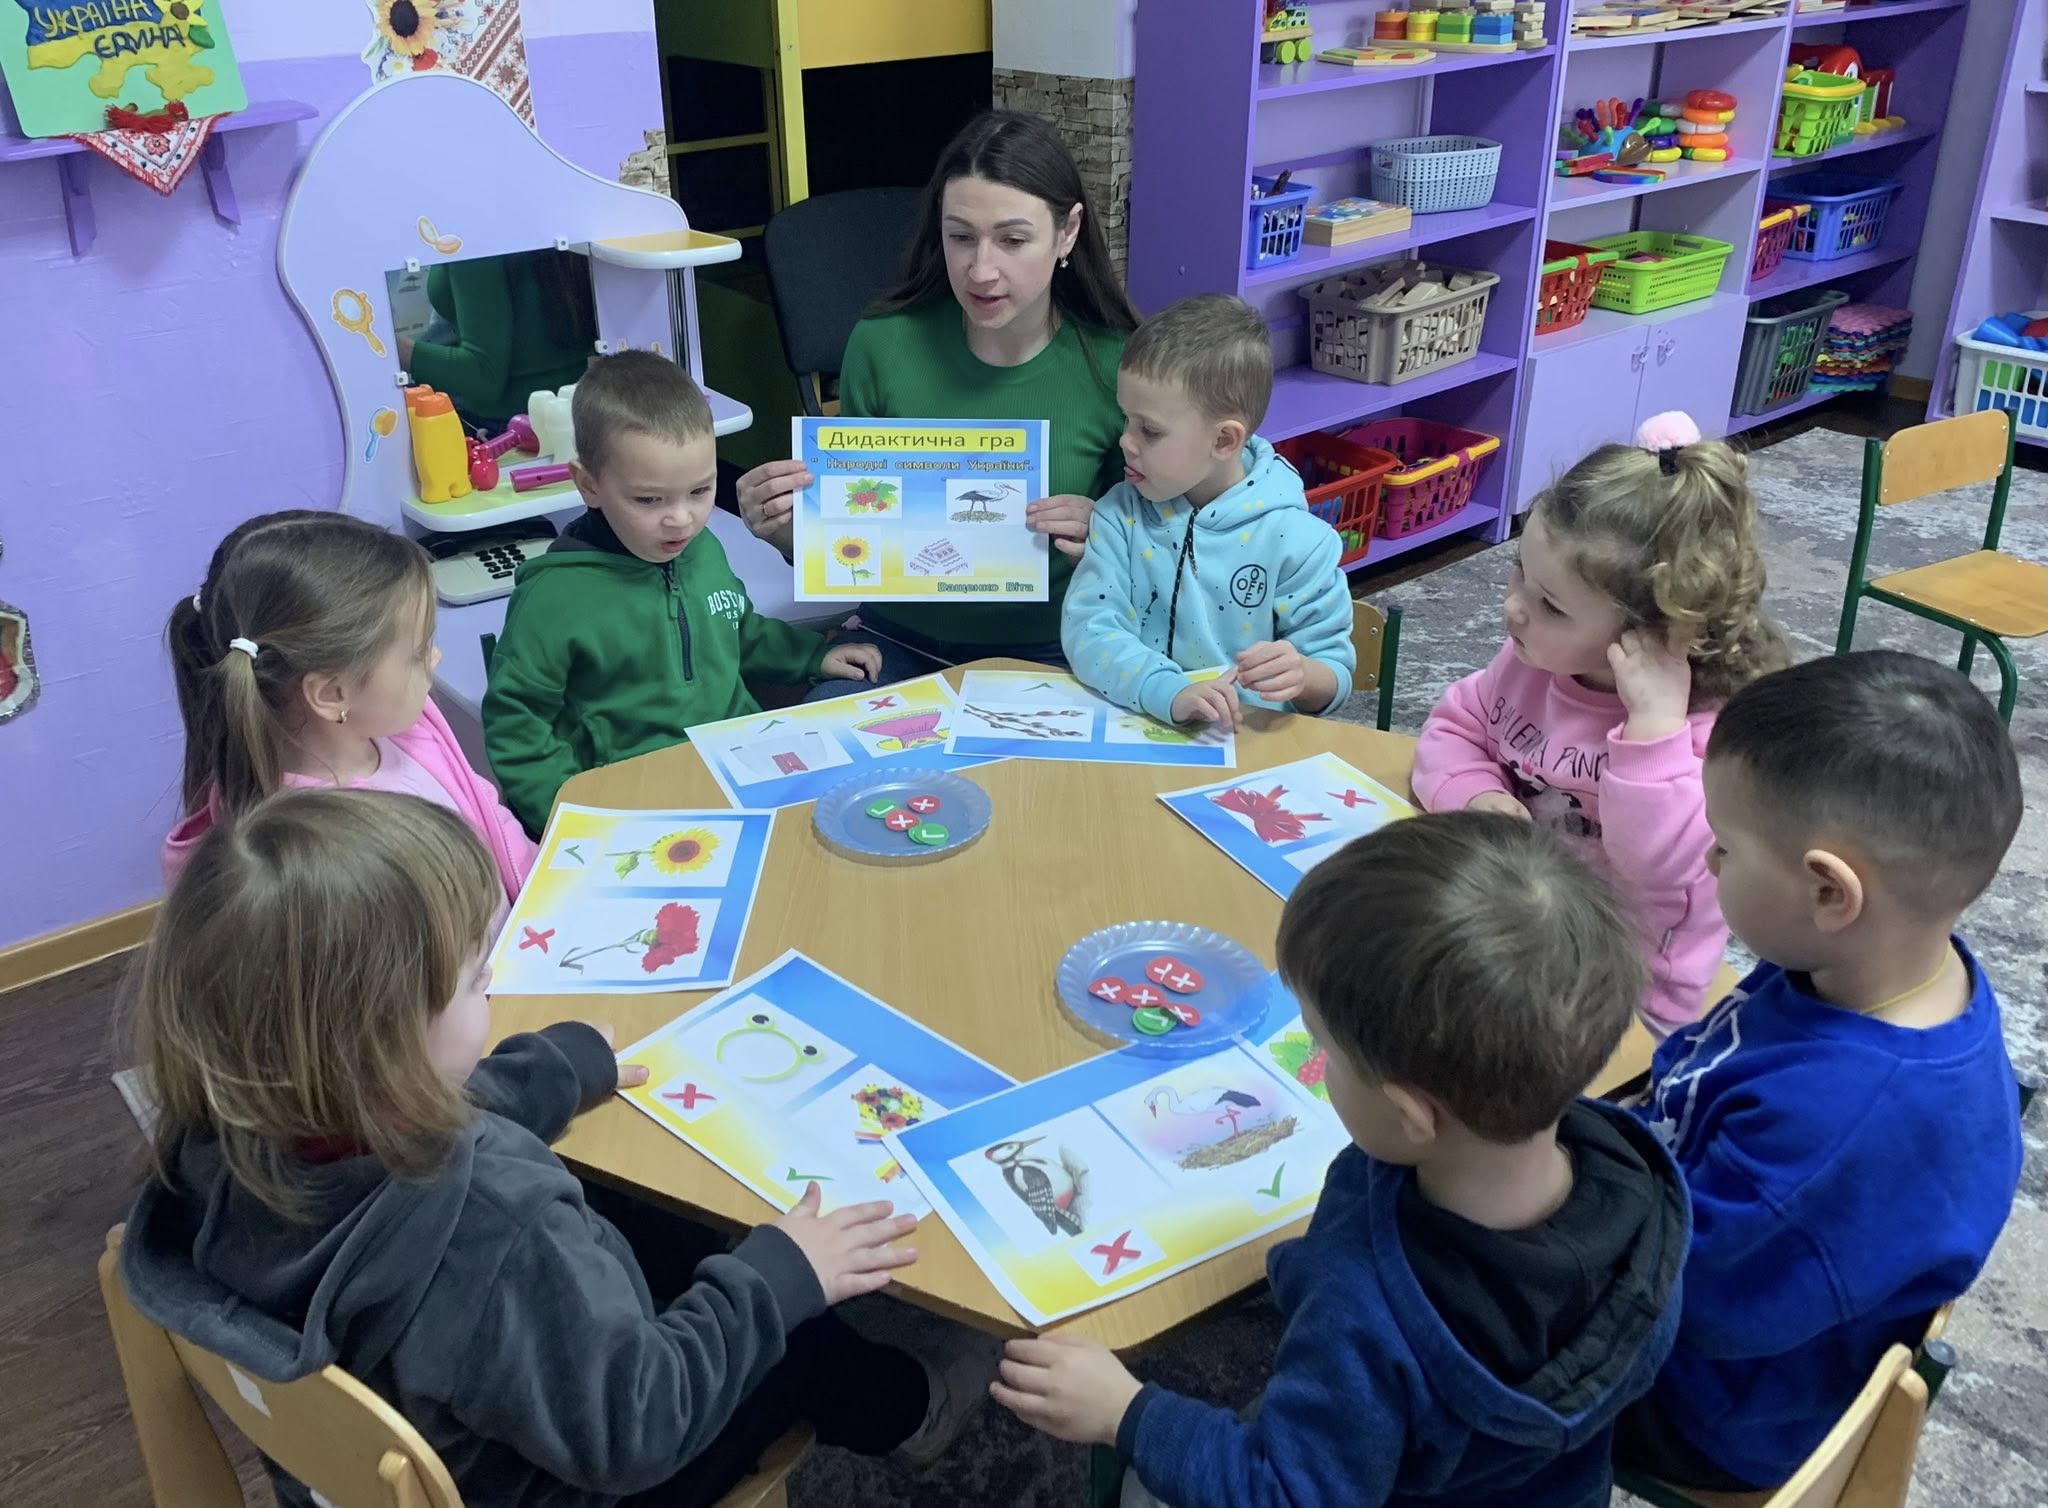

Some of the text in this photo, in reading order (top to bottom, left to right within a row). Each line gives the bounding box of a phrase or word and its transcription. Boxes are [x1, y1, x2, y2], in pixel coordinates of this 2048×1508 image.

[828, 431, 1016, 451] Дидактична гра
[827, 458, 888, 471] Народні
[895, 460, 961, 471] символи
[1005, 581, 1034, 592] Віта
[1490, 696, 1609, 782] BLLERA PAND
